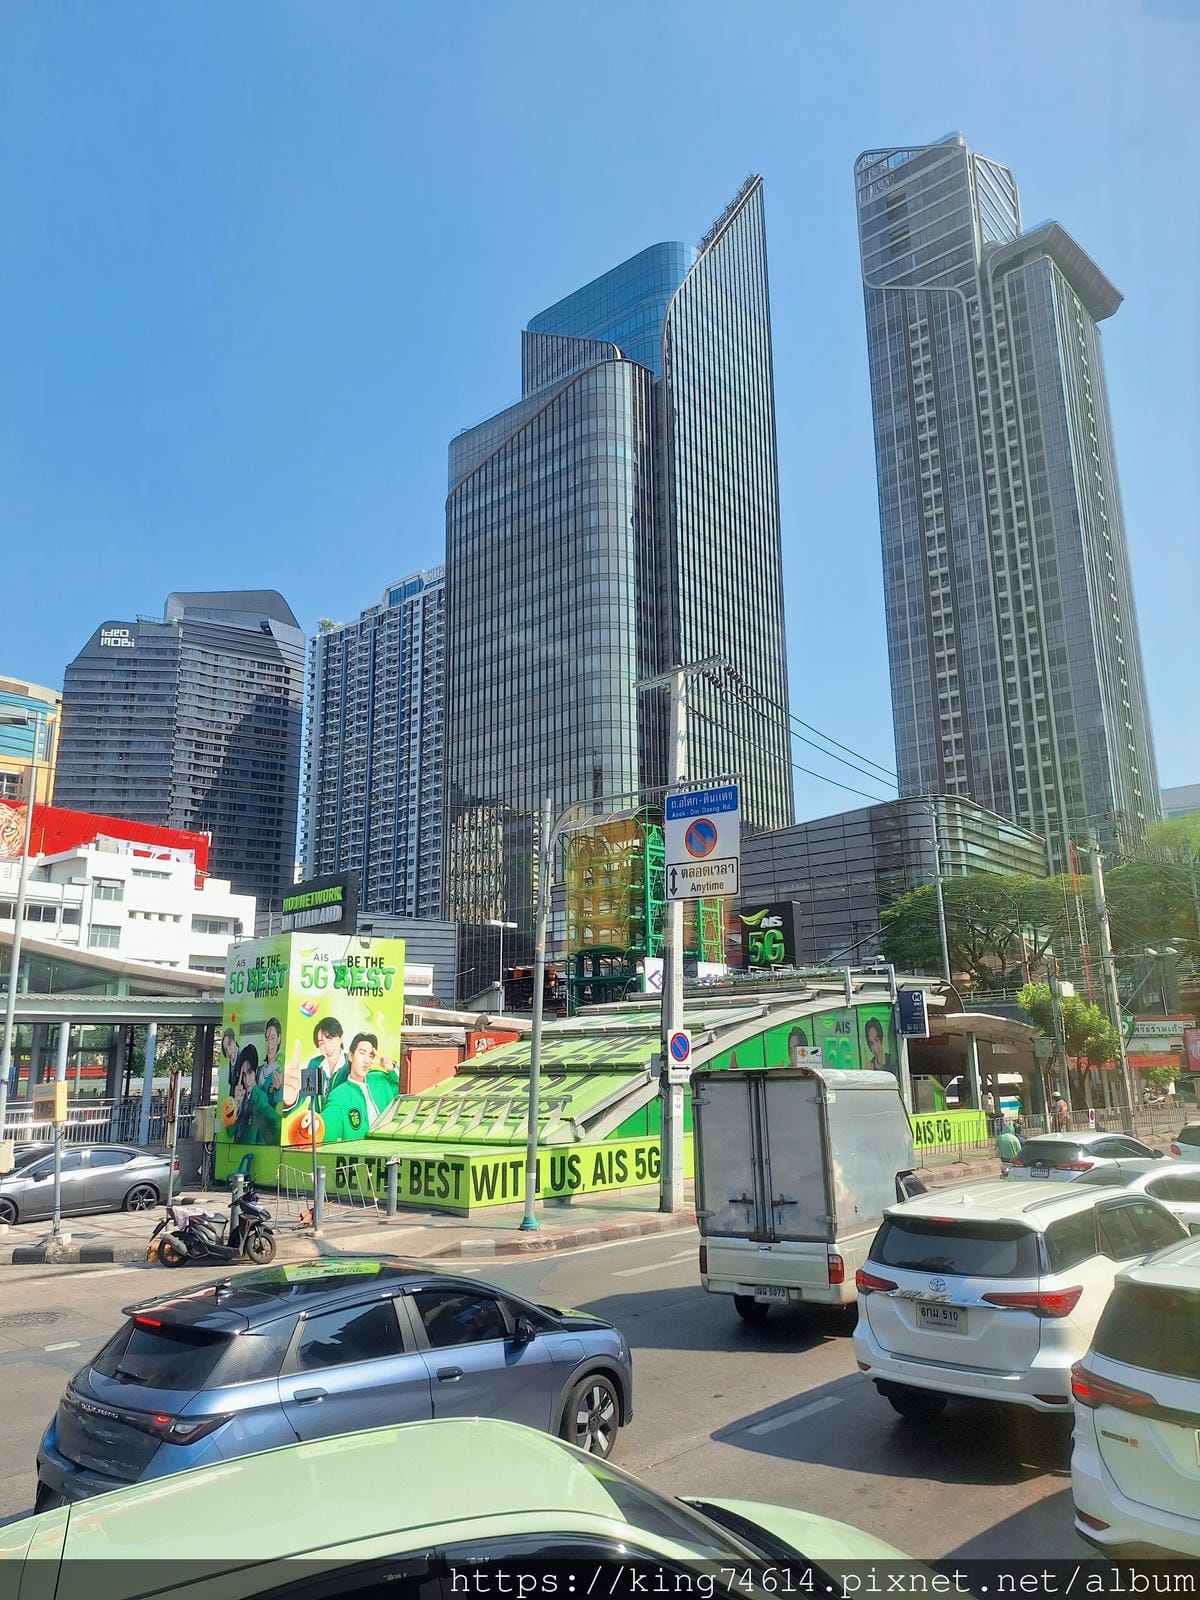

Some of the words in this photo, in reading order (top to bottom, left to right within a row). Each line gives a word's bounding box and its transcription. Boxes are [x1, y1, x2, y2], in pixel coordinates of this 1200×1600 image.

[681, 863, 734, 880] ตลอดเวลา
[690, 881, 724, 894] Anytime
[294, 905, 343, 929] THAILAND
[760, 915, 784, 929] AIS
[749, 929, 785, 965] 5G
[236, 959, 247, 968] AIS
[255, 956, 265, 970] BE
[267, 954, 281, 967] THE
[313, 953, 330, 962] AIS
[347, 955, 361, 969] BE
[364, 956, 385, 970] THE
[229, 971, 245, 995] 5G
[246, 963, 289, 993] BEST
[301, 964, 329, 990] 5G
[333, 964, 396, 991] BEST
[254, 987, 270, 999] WITH
[270, 986, 279, 998] US
[346, 986, 370, 997] WITH
[372, 987, 384, 998] US
[835, 1021, 851, 1034] AIS
[824, 1036, 854, 1069] 5G
[916, 1120, 934, 1145] AIS
[335, 1156, 359, 1190] BE
[409, 1160, 464, 1200] BEST
[550, 1154, 585, 1192] US,
[592, 1149, 628, 1186] AIS
[635, 1147, 661, 1181] 5G
[943, 1310, 959, 1321] 510
